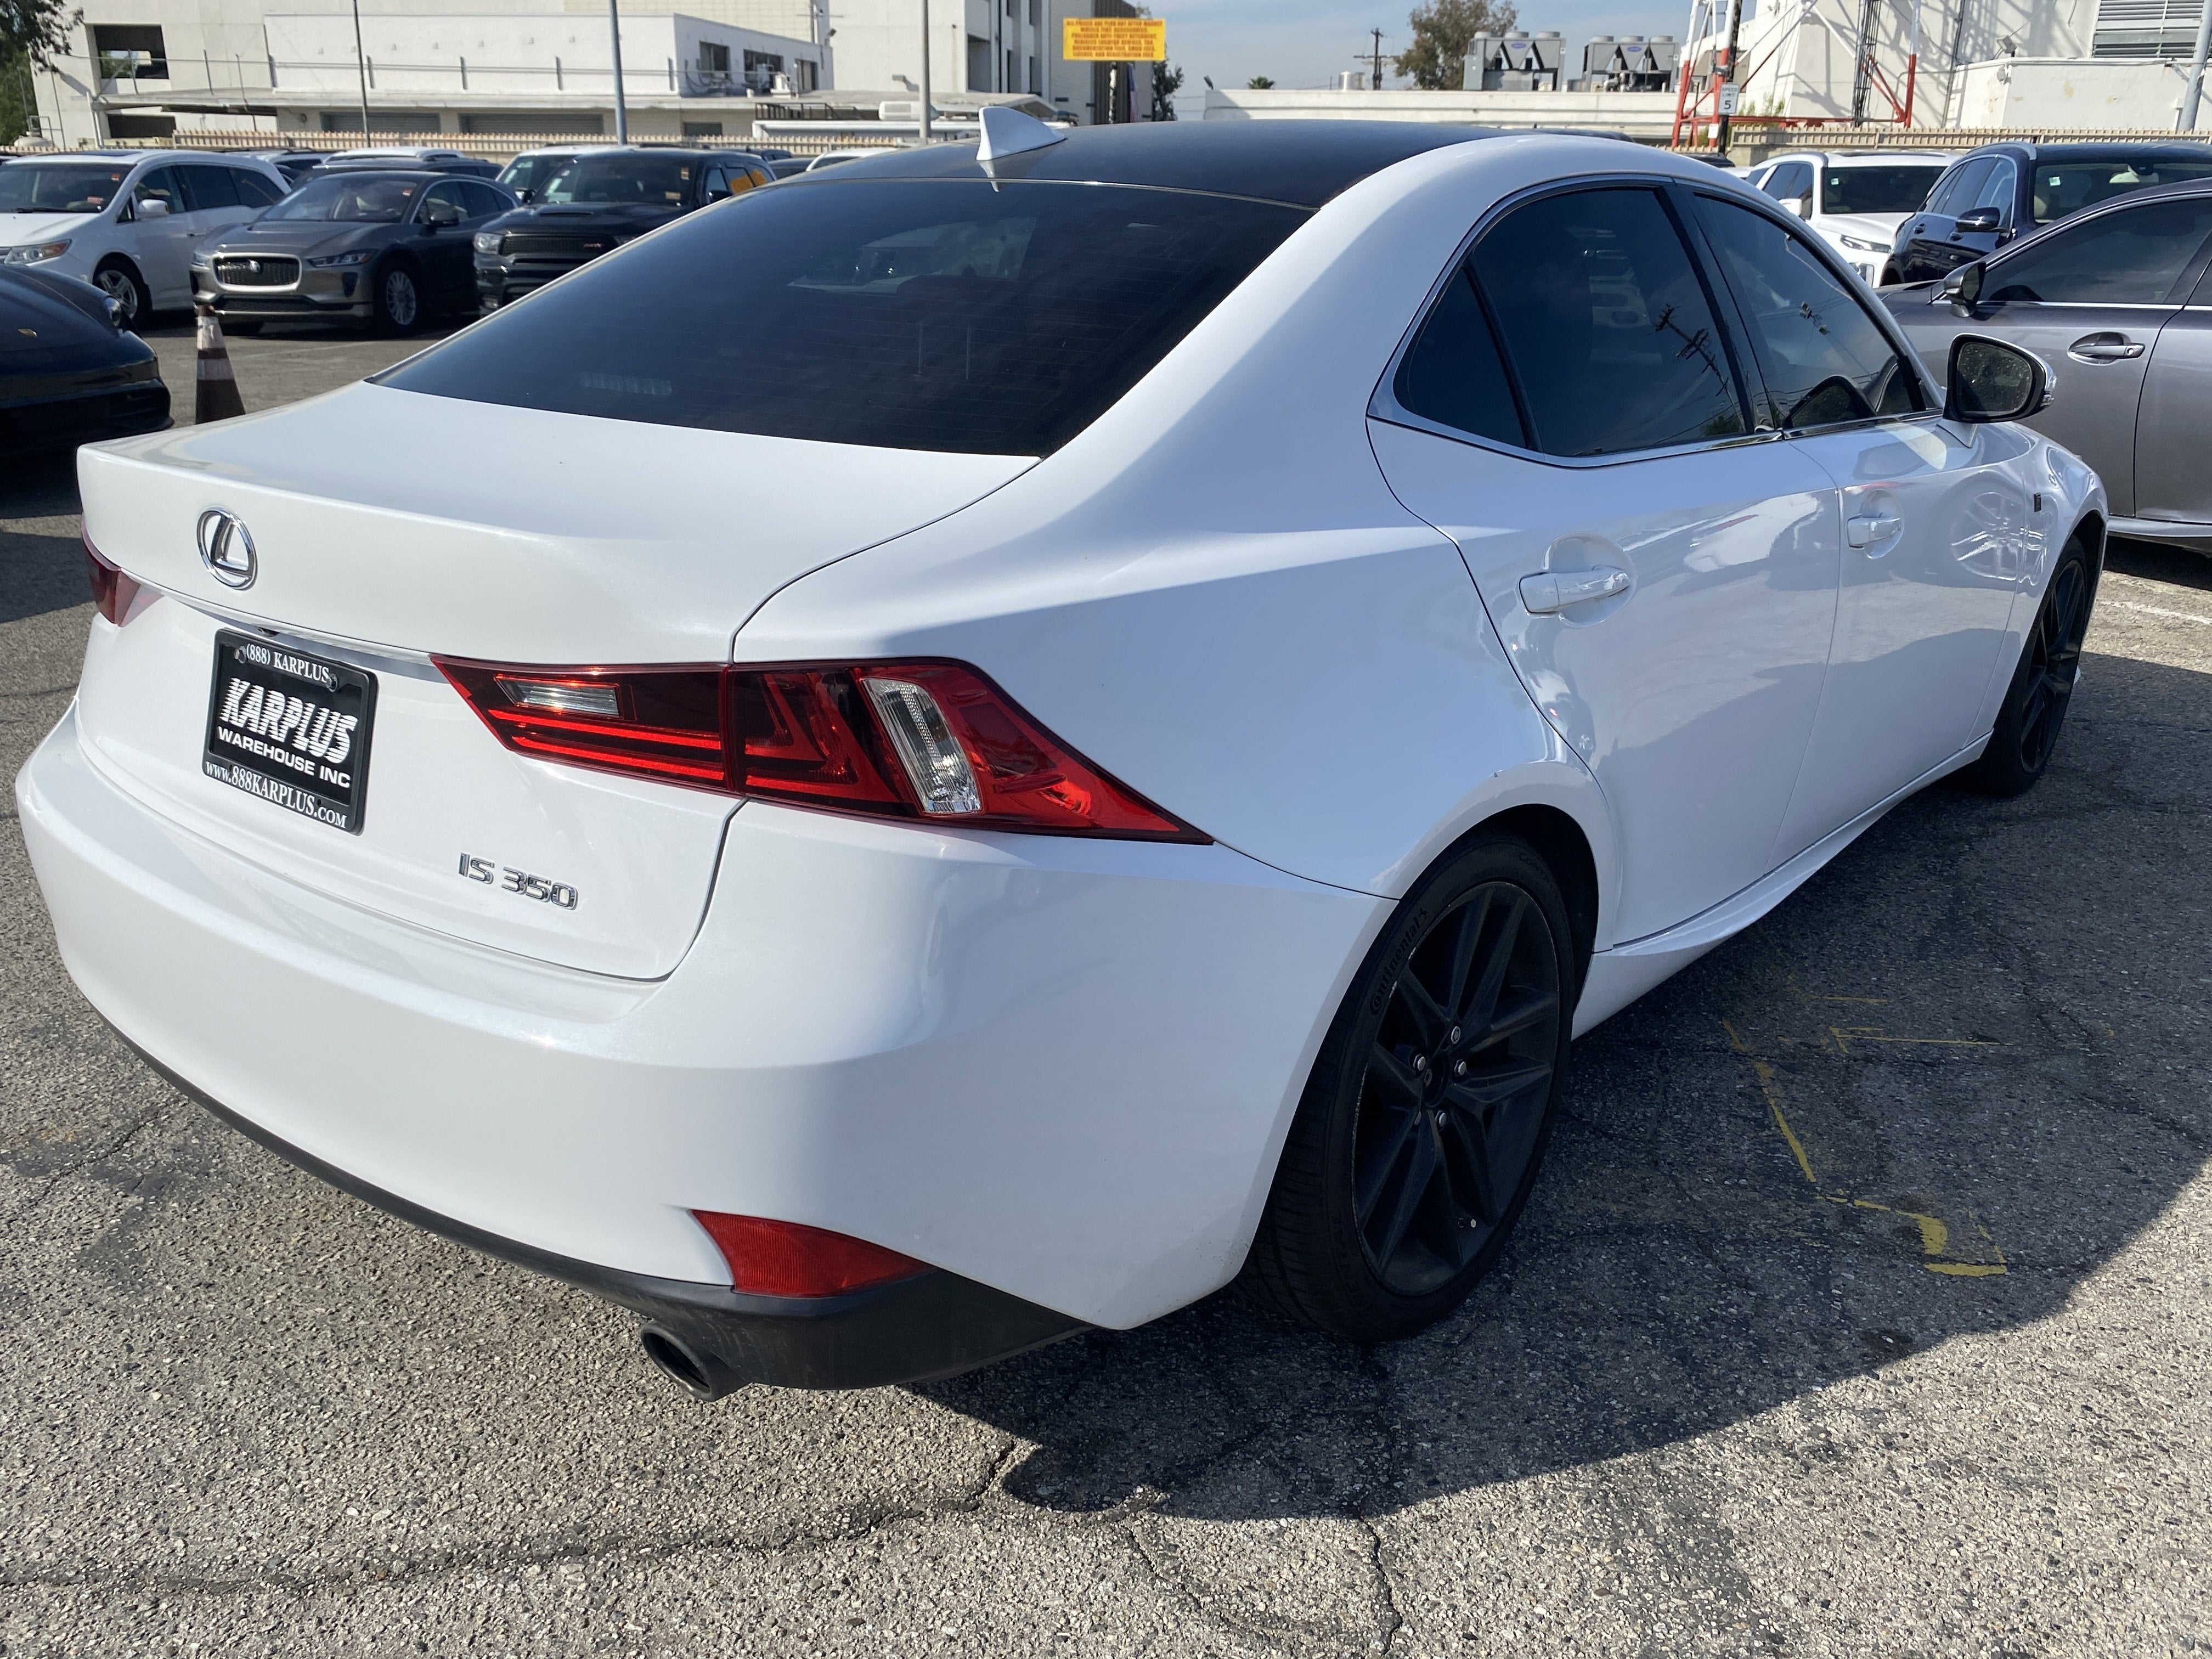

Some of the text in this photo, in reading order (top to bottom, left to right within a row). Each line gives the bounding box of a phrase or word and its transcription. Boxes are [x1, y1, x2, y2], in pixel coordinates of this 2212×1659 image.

[1724, 100, 1731, 110] 5
[246, 643, 330, 684] (888) KARPLUS
[219, 677, 358, 764] KARPLUS
[218, 725, 351, 789] WAREHOUSE INC
[459, 852, 579, 911] IS 350
[1369, 916, 1421, 1015] Continental
